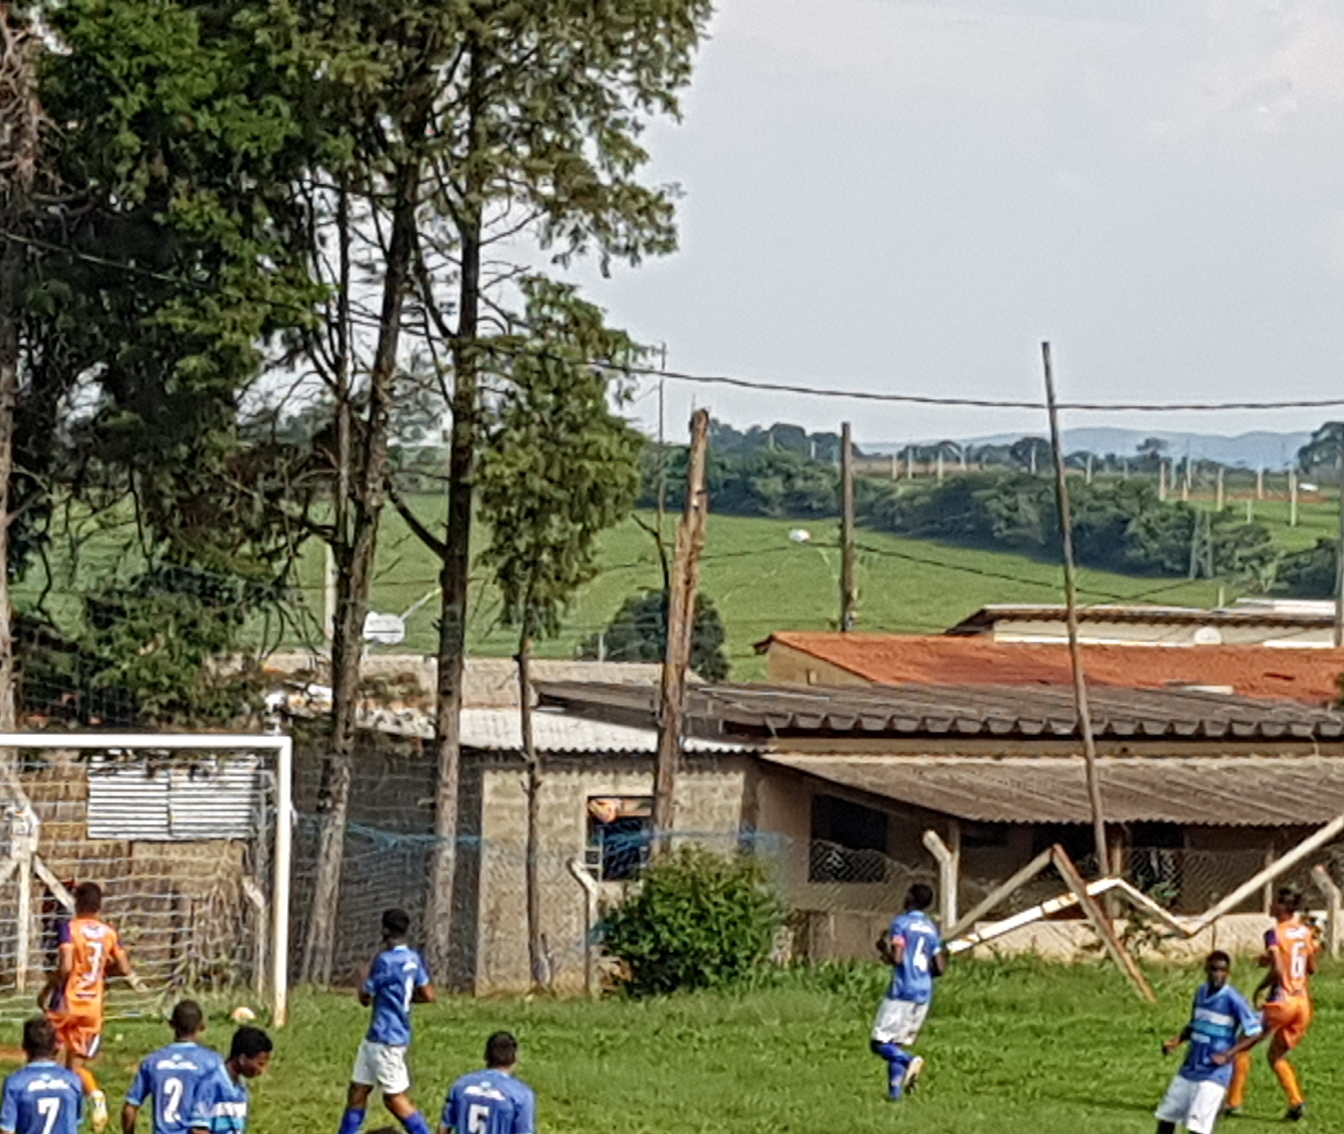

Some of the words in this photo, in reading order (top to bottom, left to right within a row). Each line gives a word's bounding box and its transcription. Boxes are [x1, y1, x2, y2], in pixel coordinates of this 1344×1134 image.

[78, 941, 103, 987] 3
[1291, 941, 1308, 979] 6
[163, 1077, 183, 1123] 2
